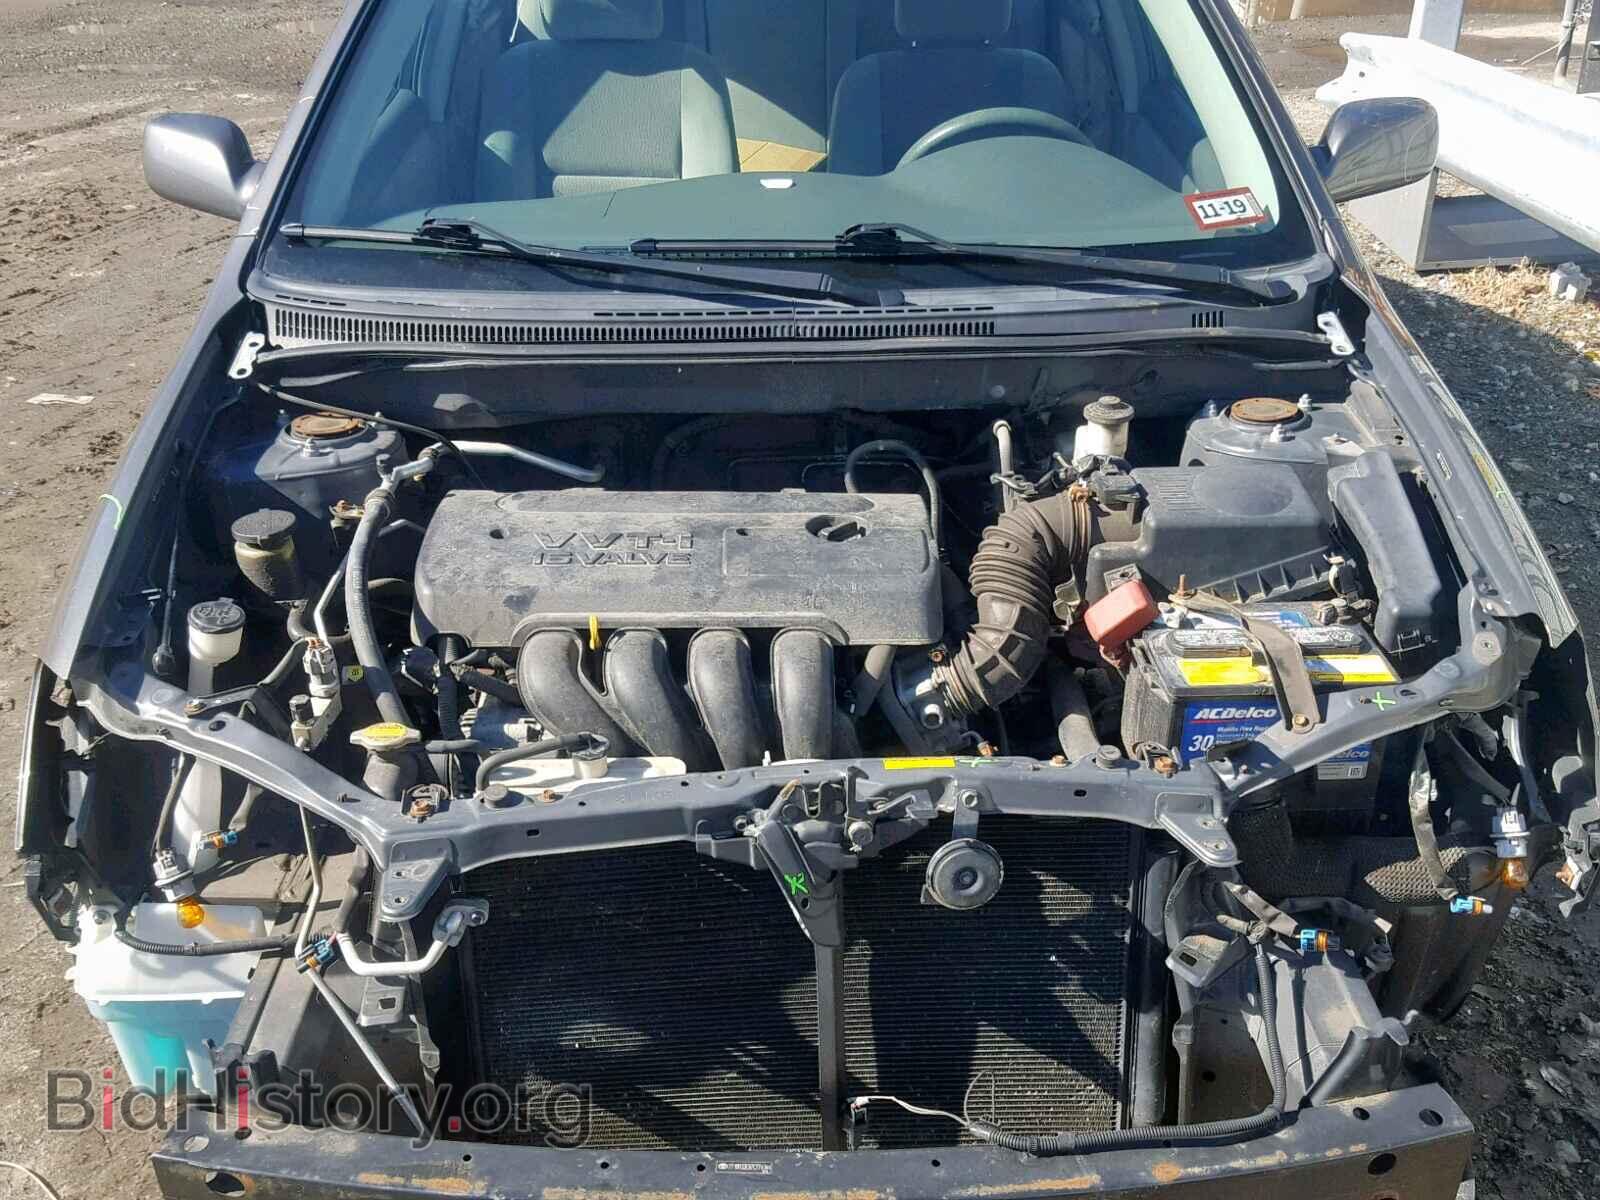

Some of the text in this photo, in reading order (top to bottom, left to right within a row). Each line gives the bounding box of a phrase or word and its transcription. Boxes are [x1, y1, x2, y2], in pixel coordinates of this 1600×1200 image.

[1198, 199, 1247, 219] 11-19
[575, 551, 692, 567] VALVE
[1193, 707, 1278, 719] ACDelco
